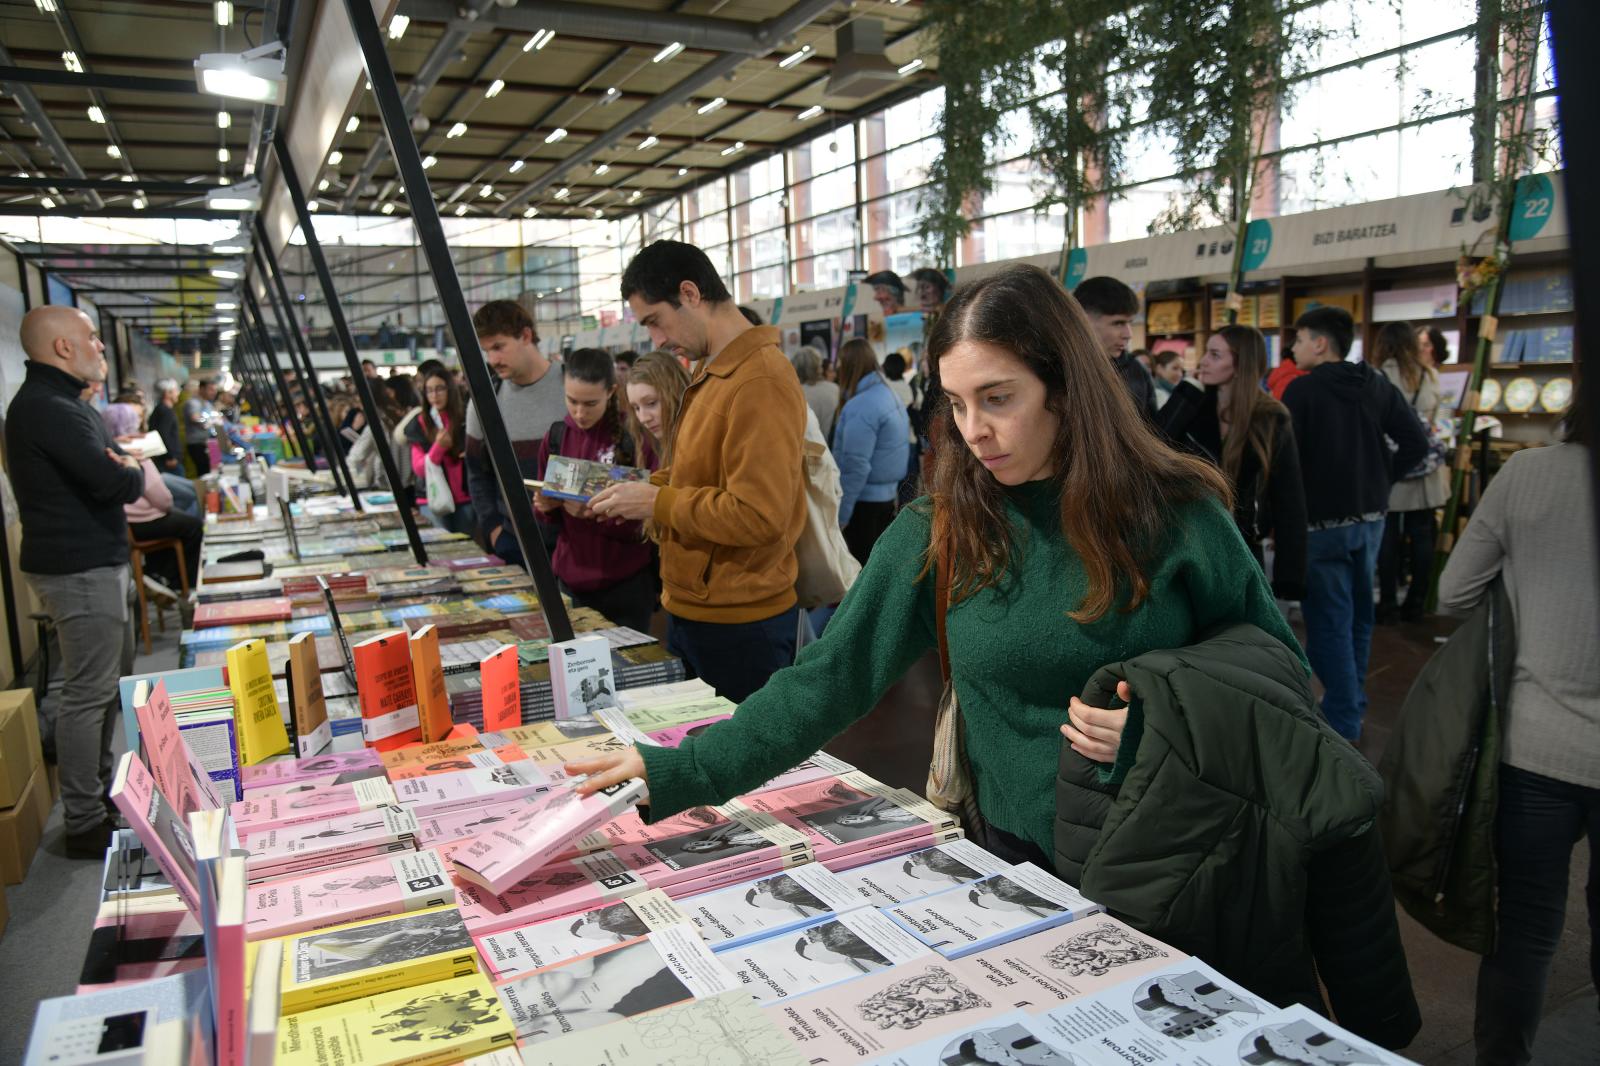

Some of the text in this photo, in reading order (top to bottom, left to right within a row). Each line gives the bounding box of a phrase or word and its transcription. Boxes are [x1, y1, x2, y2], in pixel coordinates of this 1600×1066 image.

[1523, 198, 1549, 219] 22
[1312, 222, 1398, 246] BIZI BARATZEA
[1251, 238, 1268, 255] 21
[857, 886, 871, 898] Roig
[861, 877, 901, 904] erezi-denbora
[698, 906, 735, 939] Gerezi-denbora
[893, 909, 931, 935] Montserrat
[922, 919, 939, 931] Roig
[925, 908, 978, 941] Gerezi-denbora
[507, 947, 518, 959] Roig
[737, 970, 751, 985] Roig
[744, 958, 788, 998] Gerezi-denbora
[976, 958, 1018, 987] Fernández
[1003, 958, 1030, 976] vasijas
[986, 973, 1007, 989] June
[1034, 977, 1069, 1001] Sueños
[503, 986, 525, 1022] Montserrat
[527, 1003, 540, 1022] Roig
[784, 1006, 820, 1040] Fernández
[812, 1008, 838, 1031] vasijas
[788, 1025, 809, 1041] June
[840, 1032, 869, 1057] Sueños
[1101, 1037, 1145, 1066] borroak
[1128, 1045, 1156, 1063] gero
